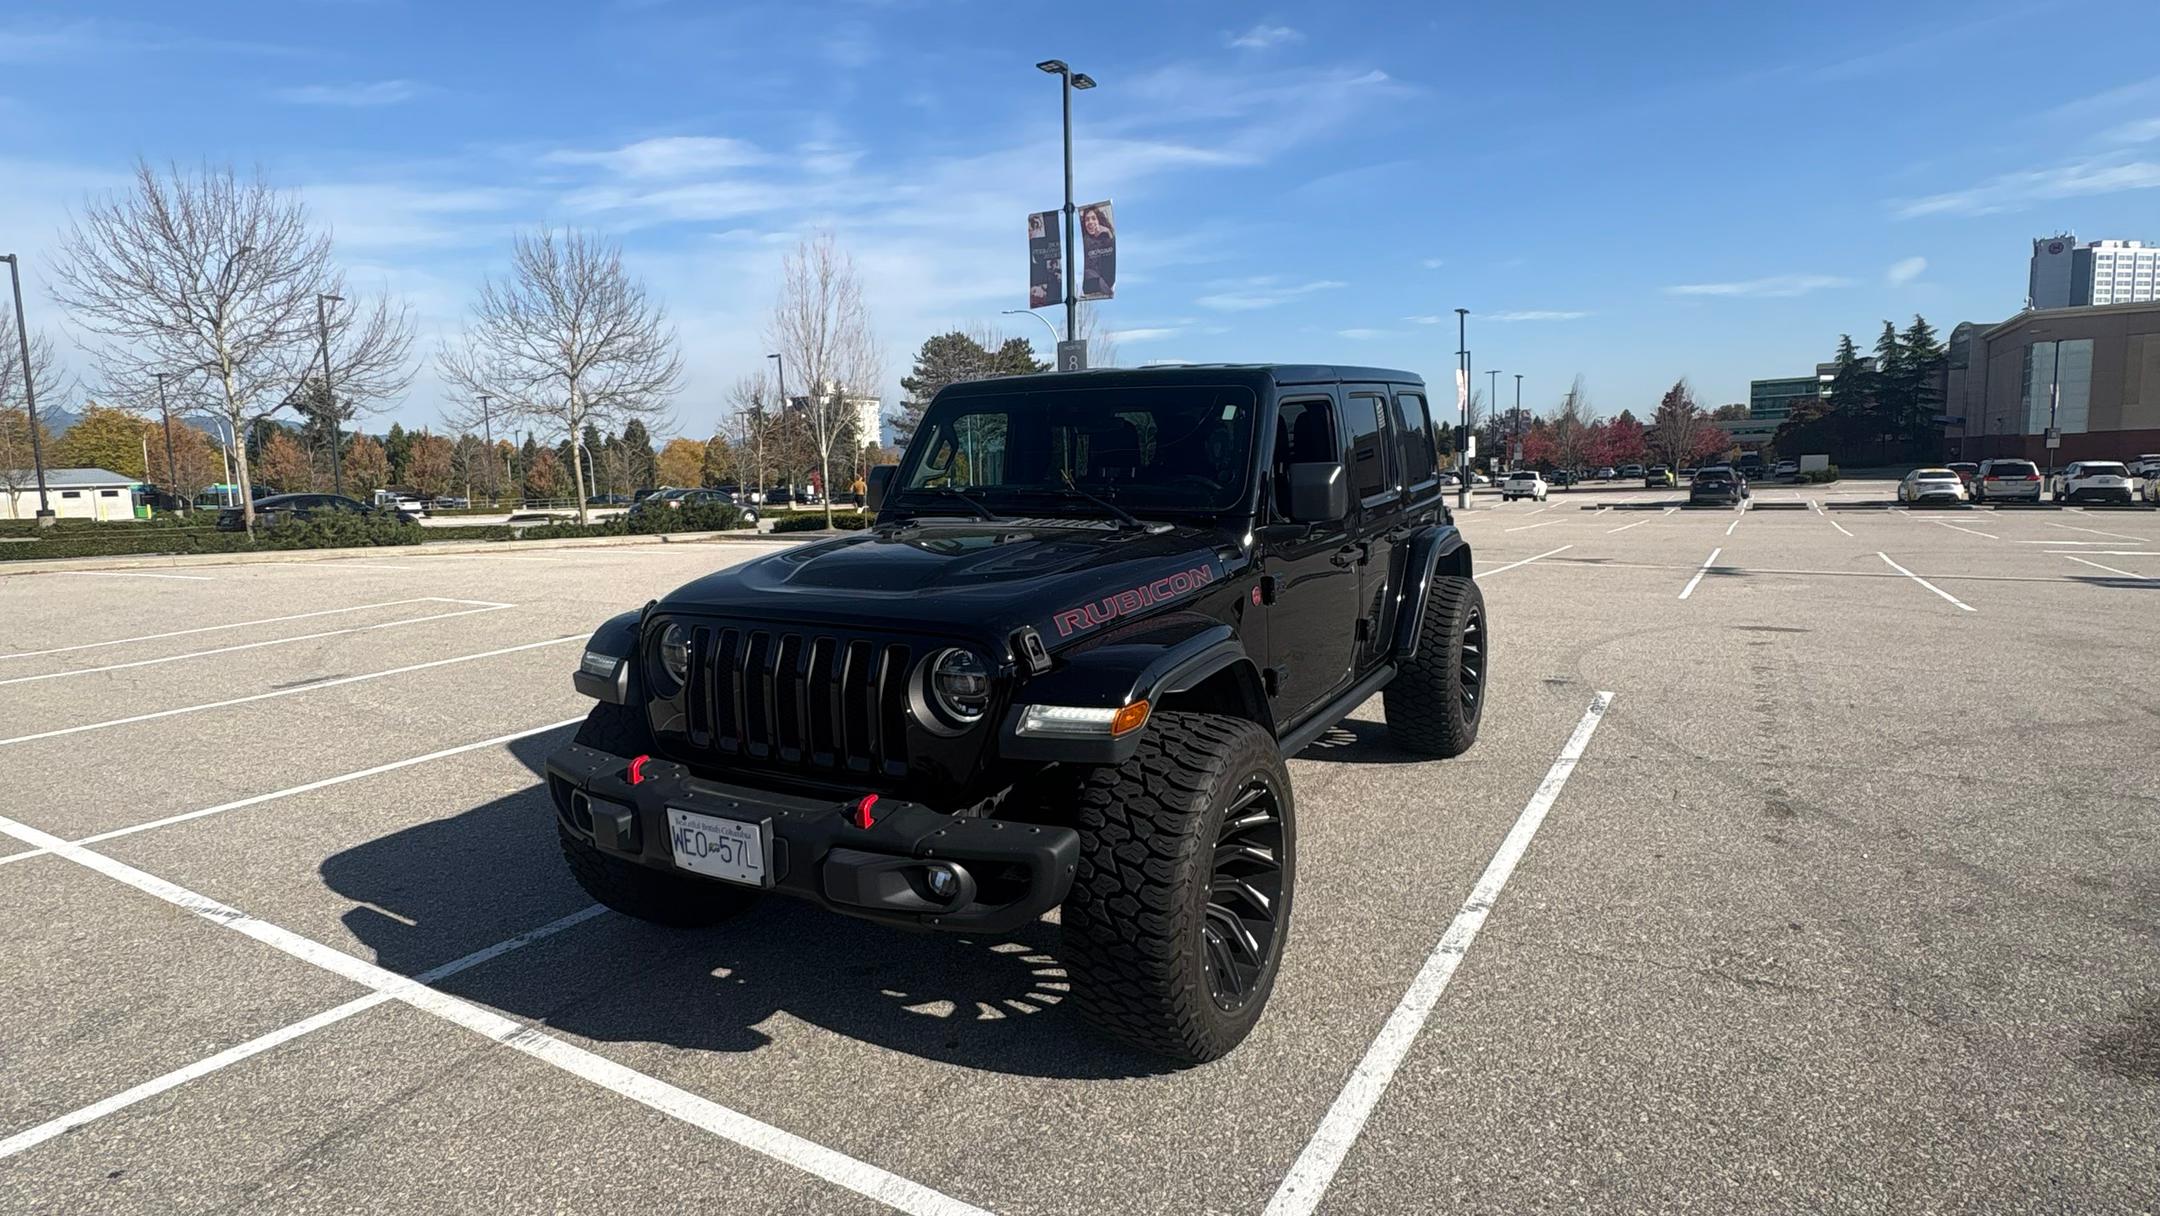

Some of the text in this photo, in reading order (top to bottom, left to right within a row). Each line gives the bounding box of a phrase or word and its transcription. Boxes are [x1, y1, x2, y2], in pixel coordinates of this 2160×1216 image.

[1069, 355, 1079, 370] 8
[1053, 564, 1214, 637] RUBICON
[719, 835, 759, 870] 57L
